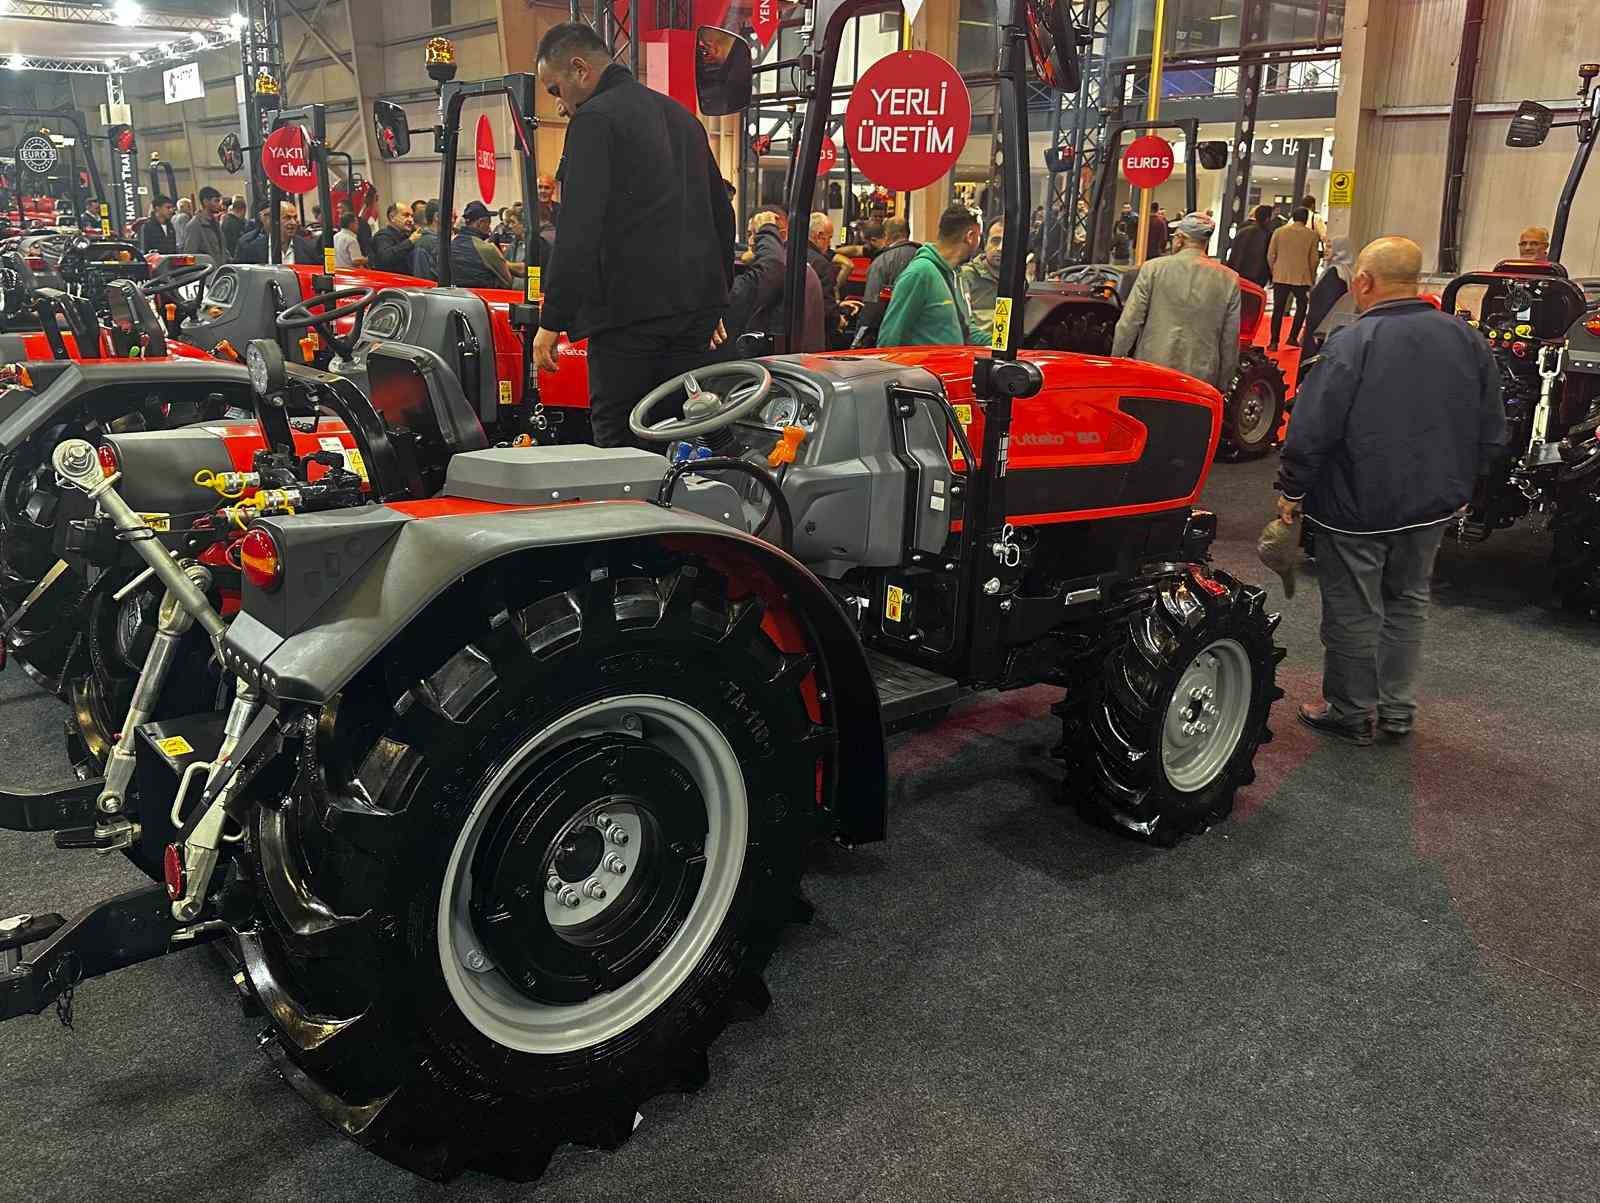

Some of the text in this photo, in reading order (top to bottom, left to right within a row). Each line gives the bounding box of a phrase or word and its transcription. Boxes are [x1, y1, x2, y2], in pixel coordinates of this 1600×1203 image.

[870, 81, 948, 115] YERLİ
[857, 119, 954, 153] ÜRETİM
[22, 151, 48, 159] EURO
[1127, 156, 1170, 169] EURO 5
